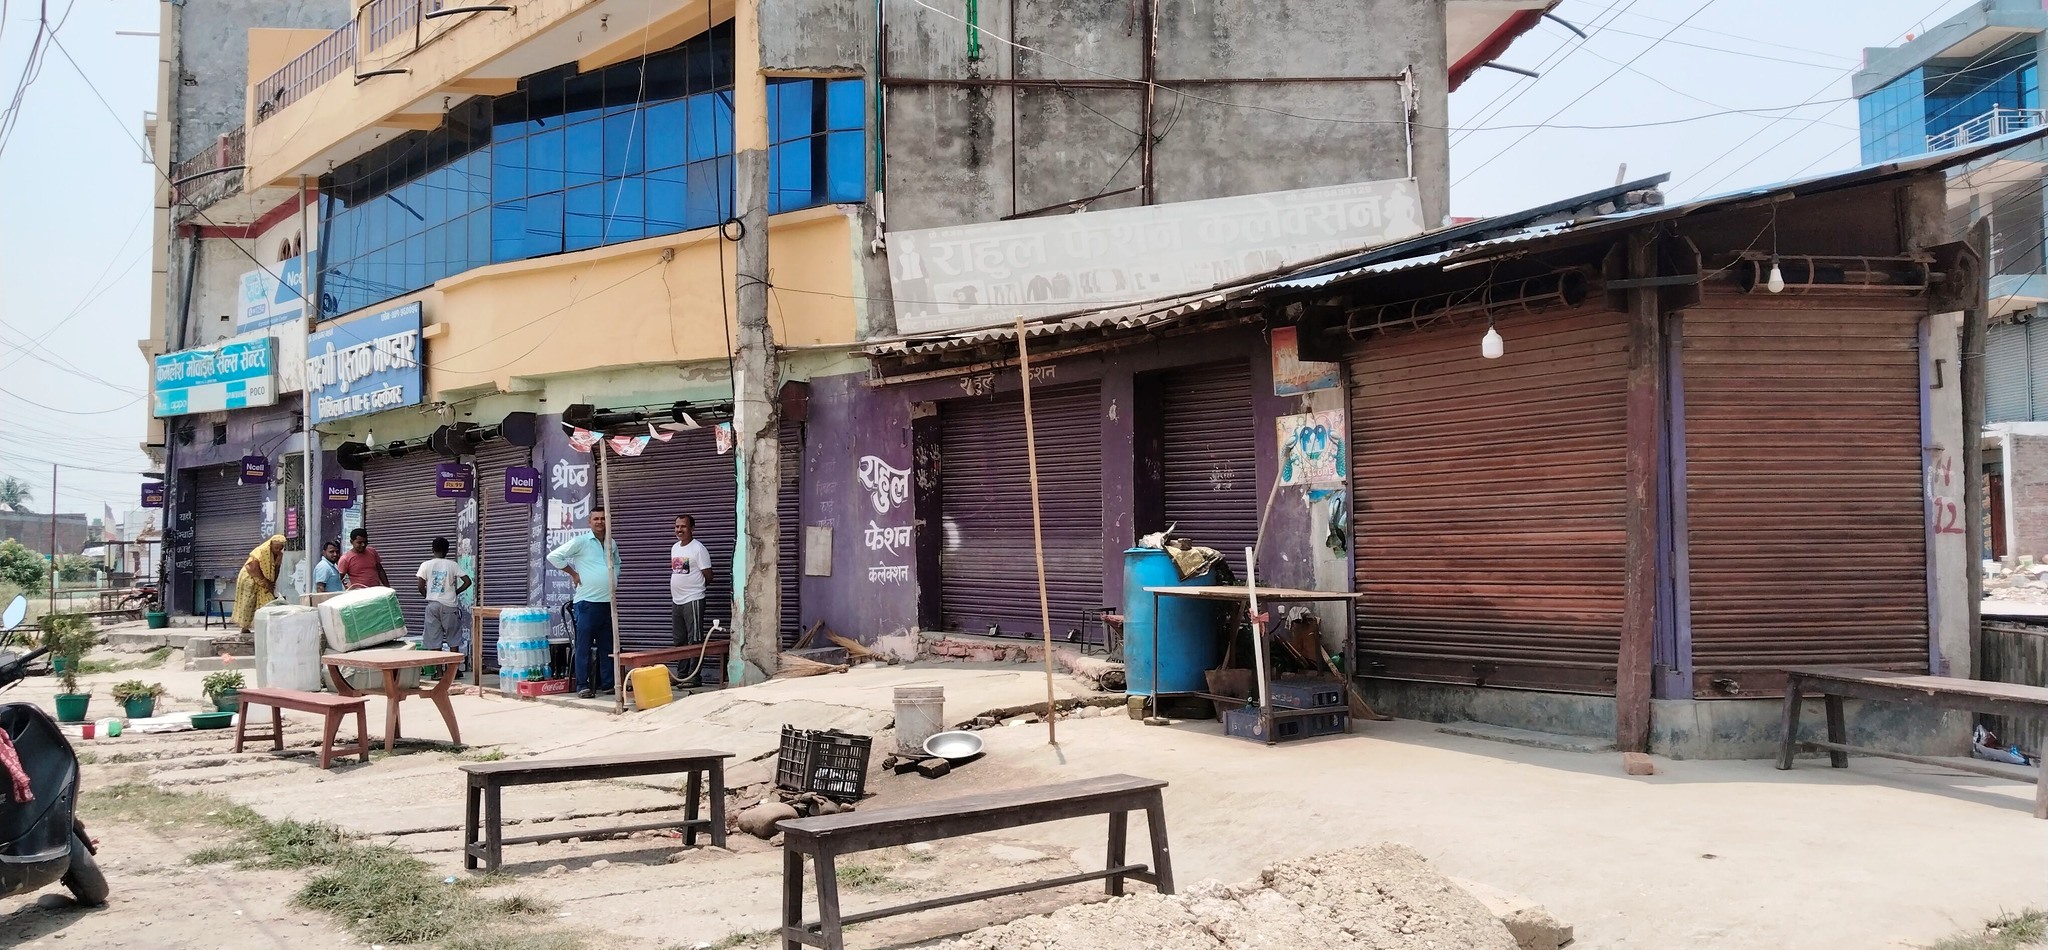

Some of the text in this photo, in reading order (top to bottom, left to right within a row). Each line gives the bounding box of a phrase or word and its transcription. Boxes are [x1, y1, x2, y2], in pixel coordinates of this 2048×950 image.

[929, 232, 1047, 280] राहुल
[287, 266, 310, 286] Ncel
[156, 358, 184, 382] कमलेश
[337, 341, 373, 393] पुस्तक
[372, 329, 418, 372] भण्डार
[249, 386, 265, 396] POCO
[960, 372, 995, 395] रहुल
[246, 463, 265, 471] Ncell
[551, 458, 590, 490] श्रेष्ठ
[328, 487, 349, 495] Ncell
[511, 476, 534, 487] Ncell
[858, 455, 911, 515] राहुल
[865, 520, 913, 556] फेशन
[868, 561, 909, 585] कलेक्शन
